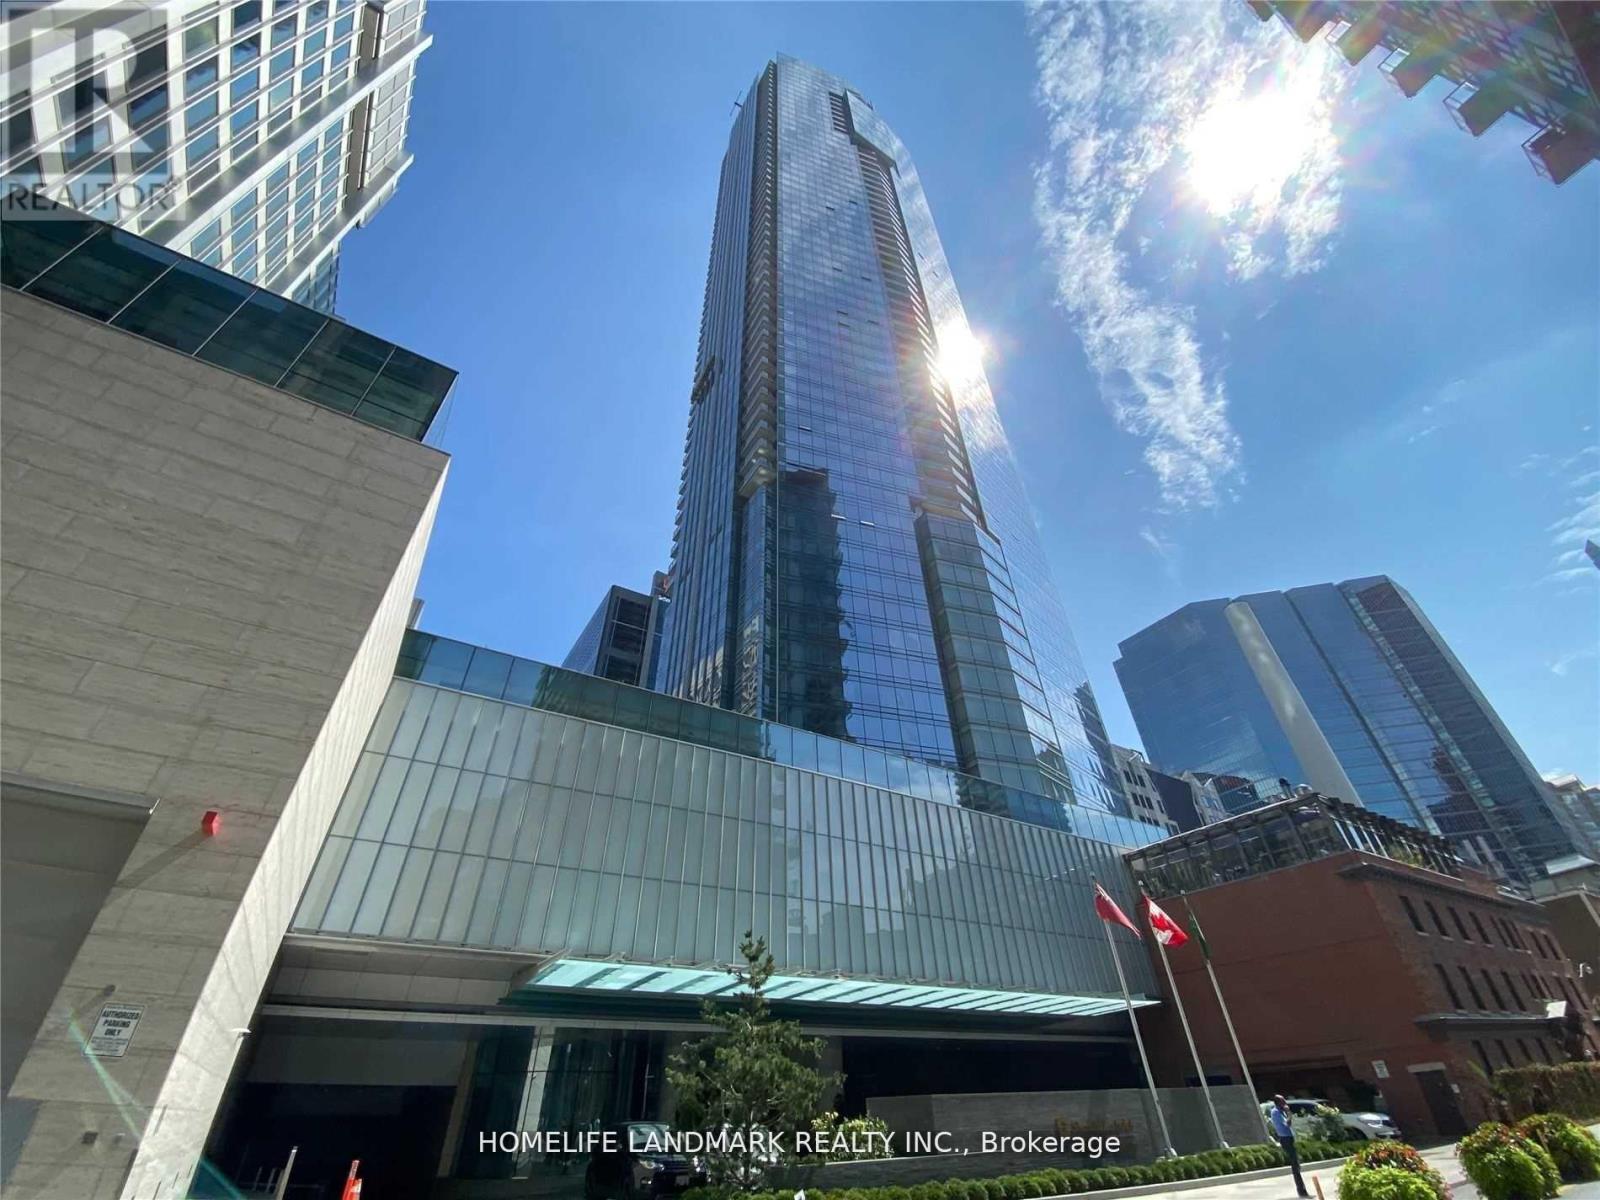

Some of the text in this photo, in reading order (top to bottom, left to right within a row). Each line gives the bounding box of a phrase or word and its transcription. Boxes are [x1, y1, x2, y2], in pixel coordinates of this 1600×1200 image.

[102, 1010, 139, 1019] AUTHORIZED
[103, 1019, 130, 1028] PARKING
[104, 1028, 121, 1036] ONLY
